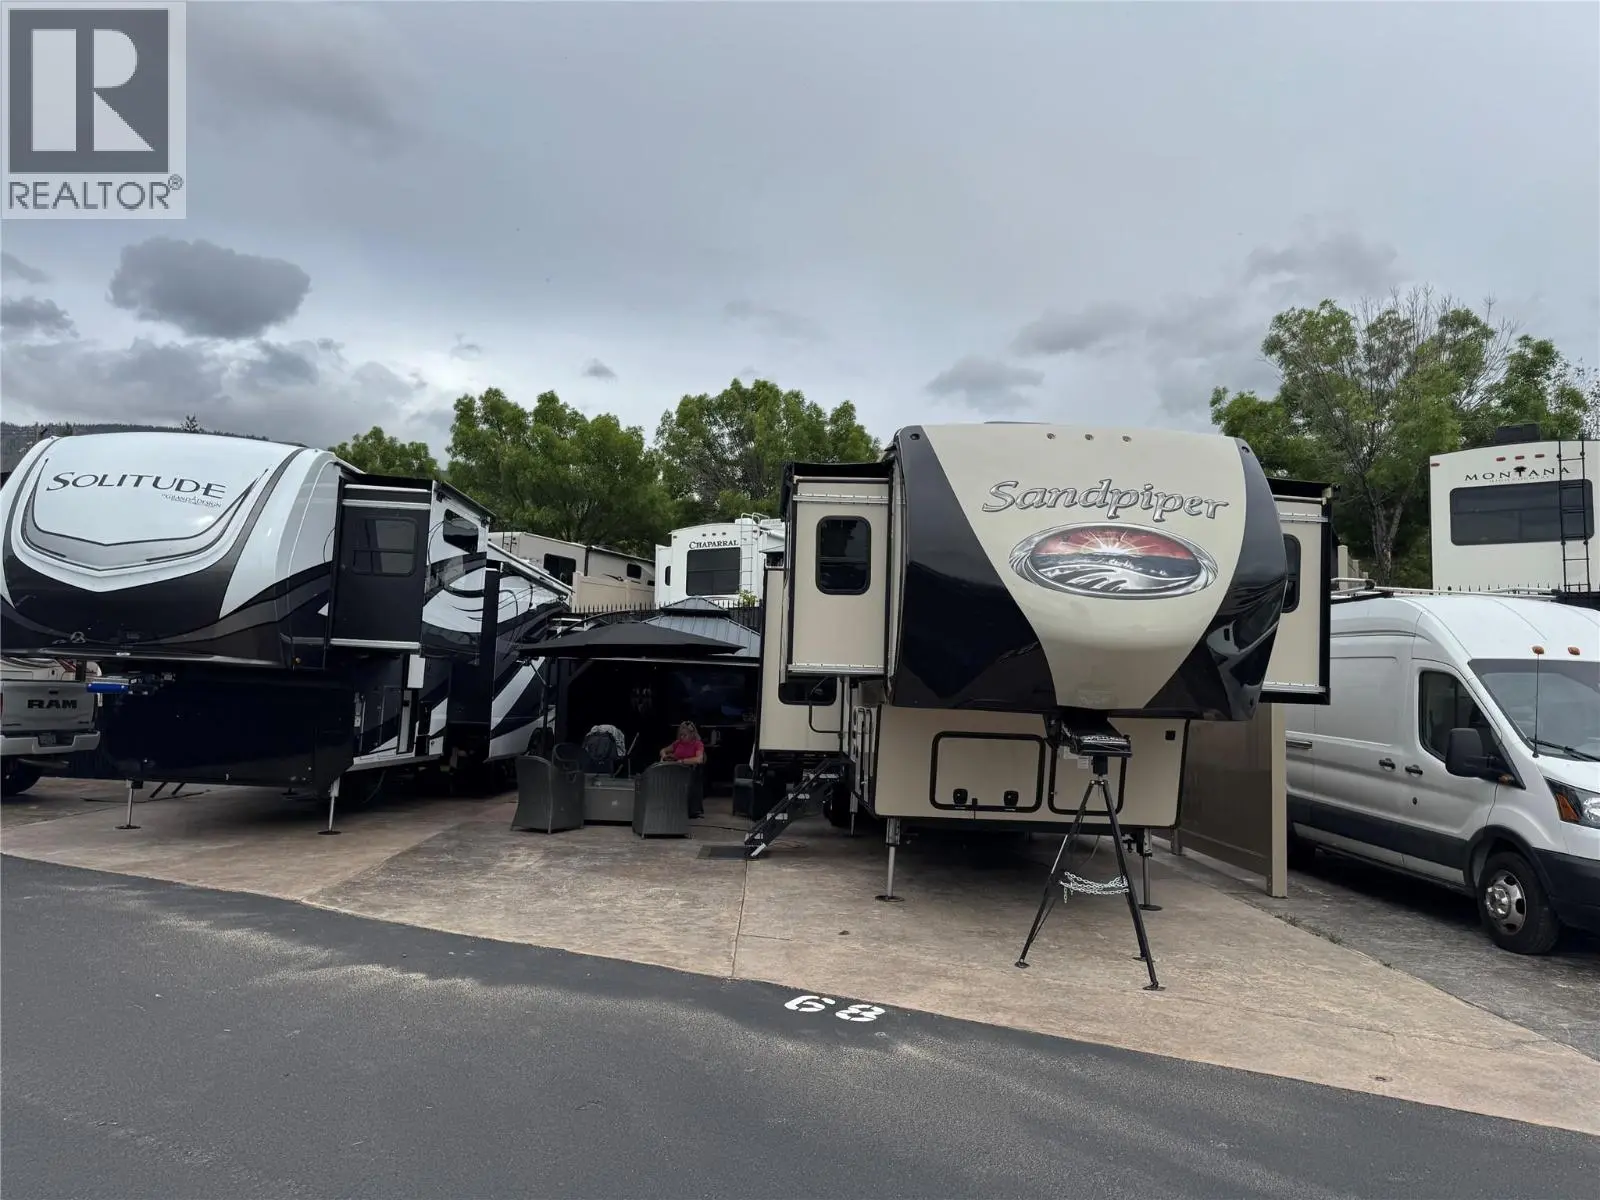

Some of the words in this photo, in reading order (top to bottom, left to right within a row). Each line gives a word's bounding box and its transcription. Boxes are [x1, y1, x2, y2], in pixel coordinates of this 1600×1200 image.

[1464, 466, 1571, 482] MONTANA
[46, 471, 227, 499] SOLITUDE
[981, 478, 1230, 523] Sandpiper
[688, 539, 739, 550] CHAPARRAL
[27, 699, 77, 709] RAM
[784, 995, 886, 1022] 68
